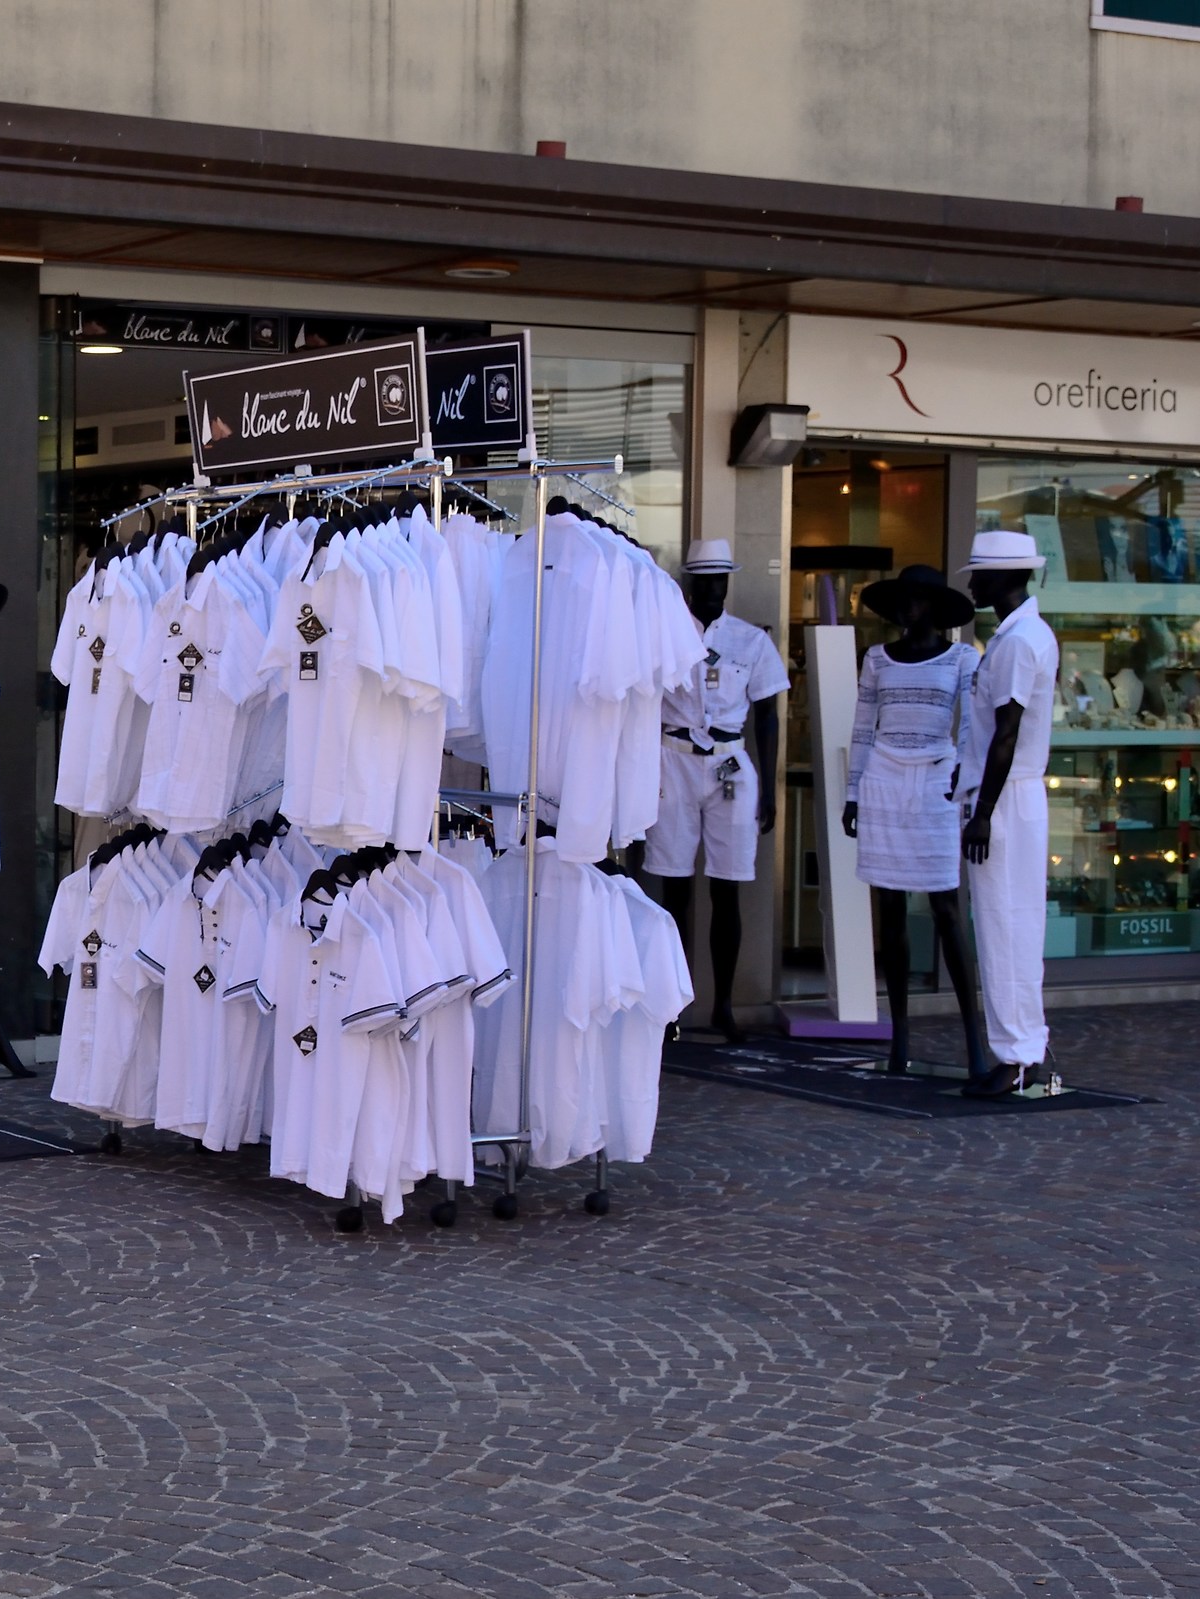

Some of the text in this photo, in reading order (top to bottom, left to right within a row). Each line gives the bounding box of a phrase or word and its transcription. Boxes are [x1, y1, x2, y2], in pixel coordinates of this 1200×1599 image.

[177, 320, 200, 342] du
[204, 319, 235, 345] Nil
[295, 389, 321, 431] du
[326, 376, 361, 431] Nil
[436, 373, 471, 425] Nil
[1034, 368, 1178, 413] oreficeria
[1120, 918, 1174, 935] FOSSIL
